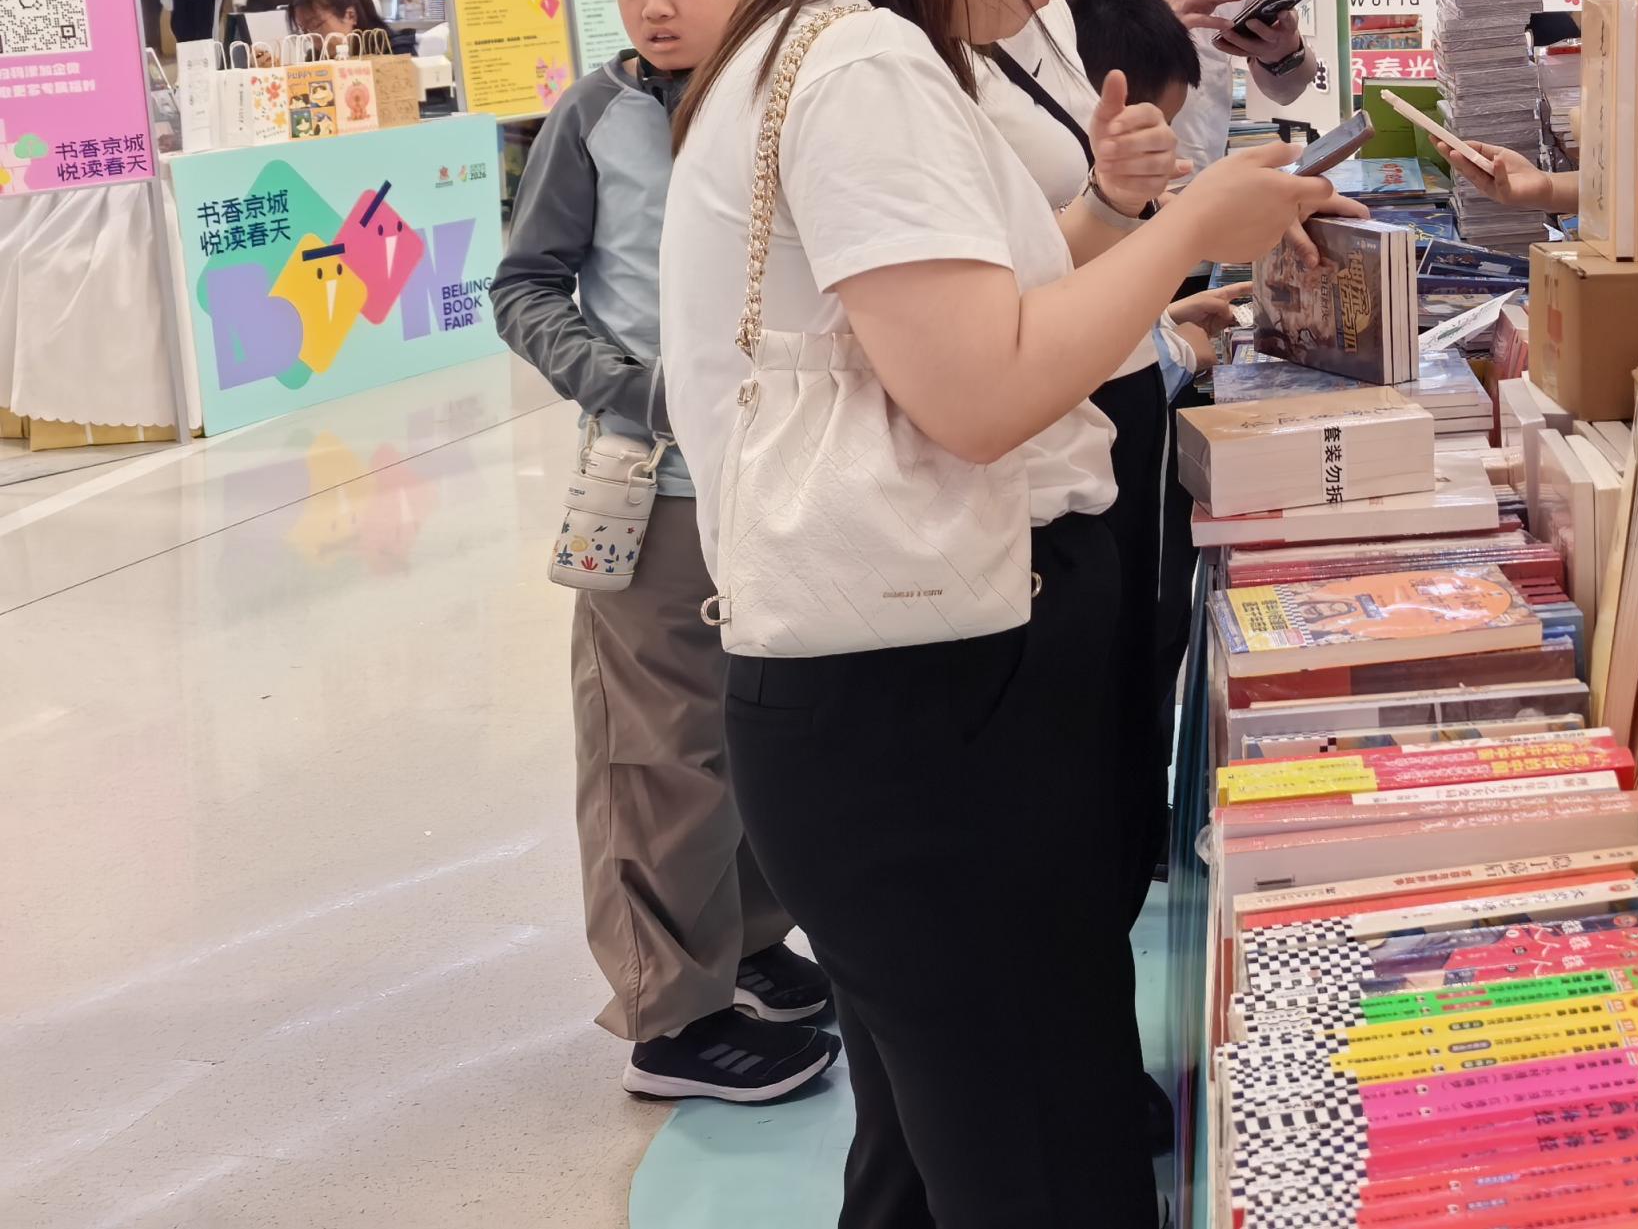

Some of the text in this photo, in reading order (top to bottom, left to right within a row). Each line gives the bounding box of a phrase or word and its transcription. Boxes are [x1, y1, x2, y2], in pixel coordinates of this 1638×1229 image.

[55, 133, 146, 161] 书香京城
[57, 154, 148, 182] 悦读春天
[197, 189, 290, 228] 书香京城
[200, 218, 292, 257] 悦读春天
[441, 276, 493, 301] BEIJING
[443, 296, 483, 316] BOOK
[444, 313, 475, 332] FAIR
[1322, 425, 1346, 508] 套装勿拆
